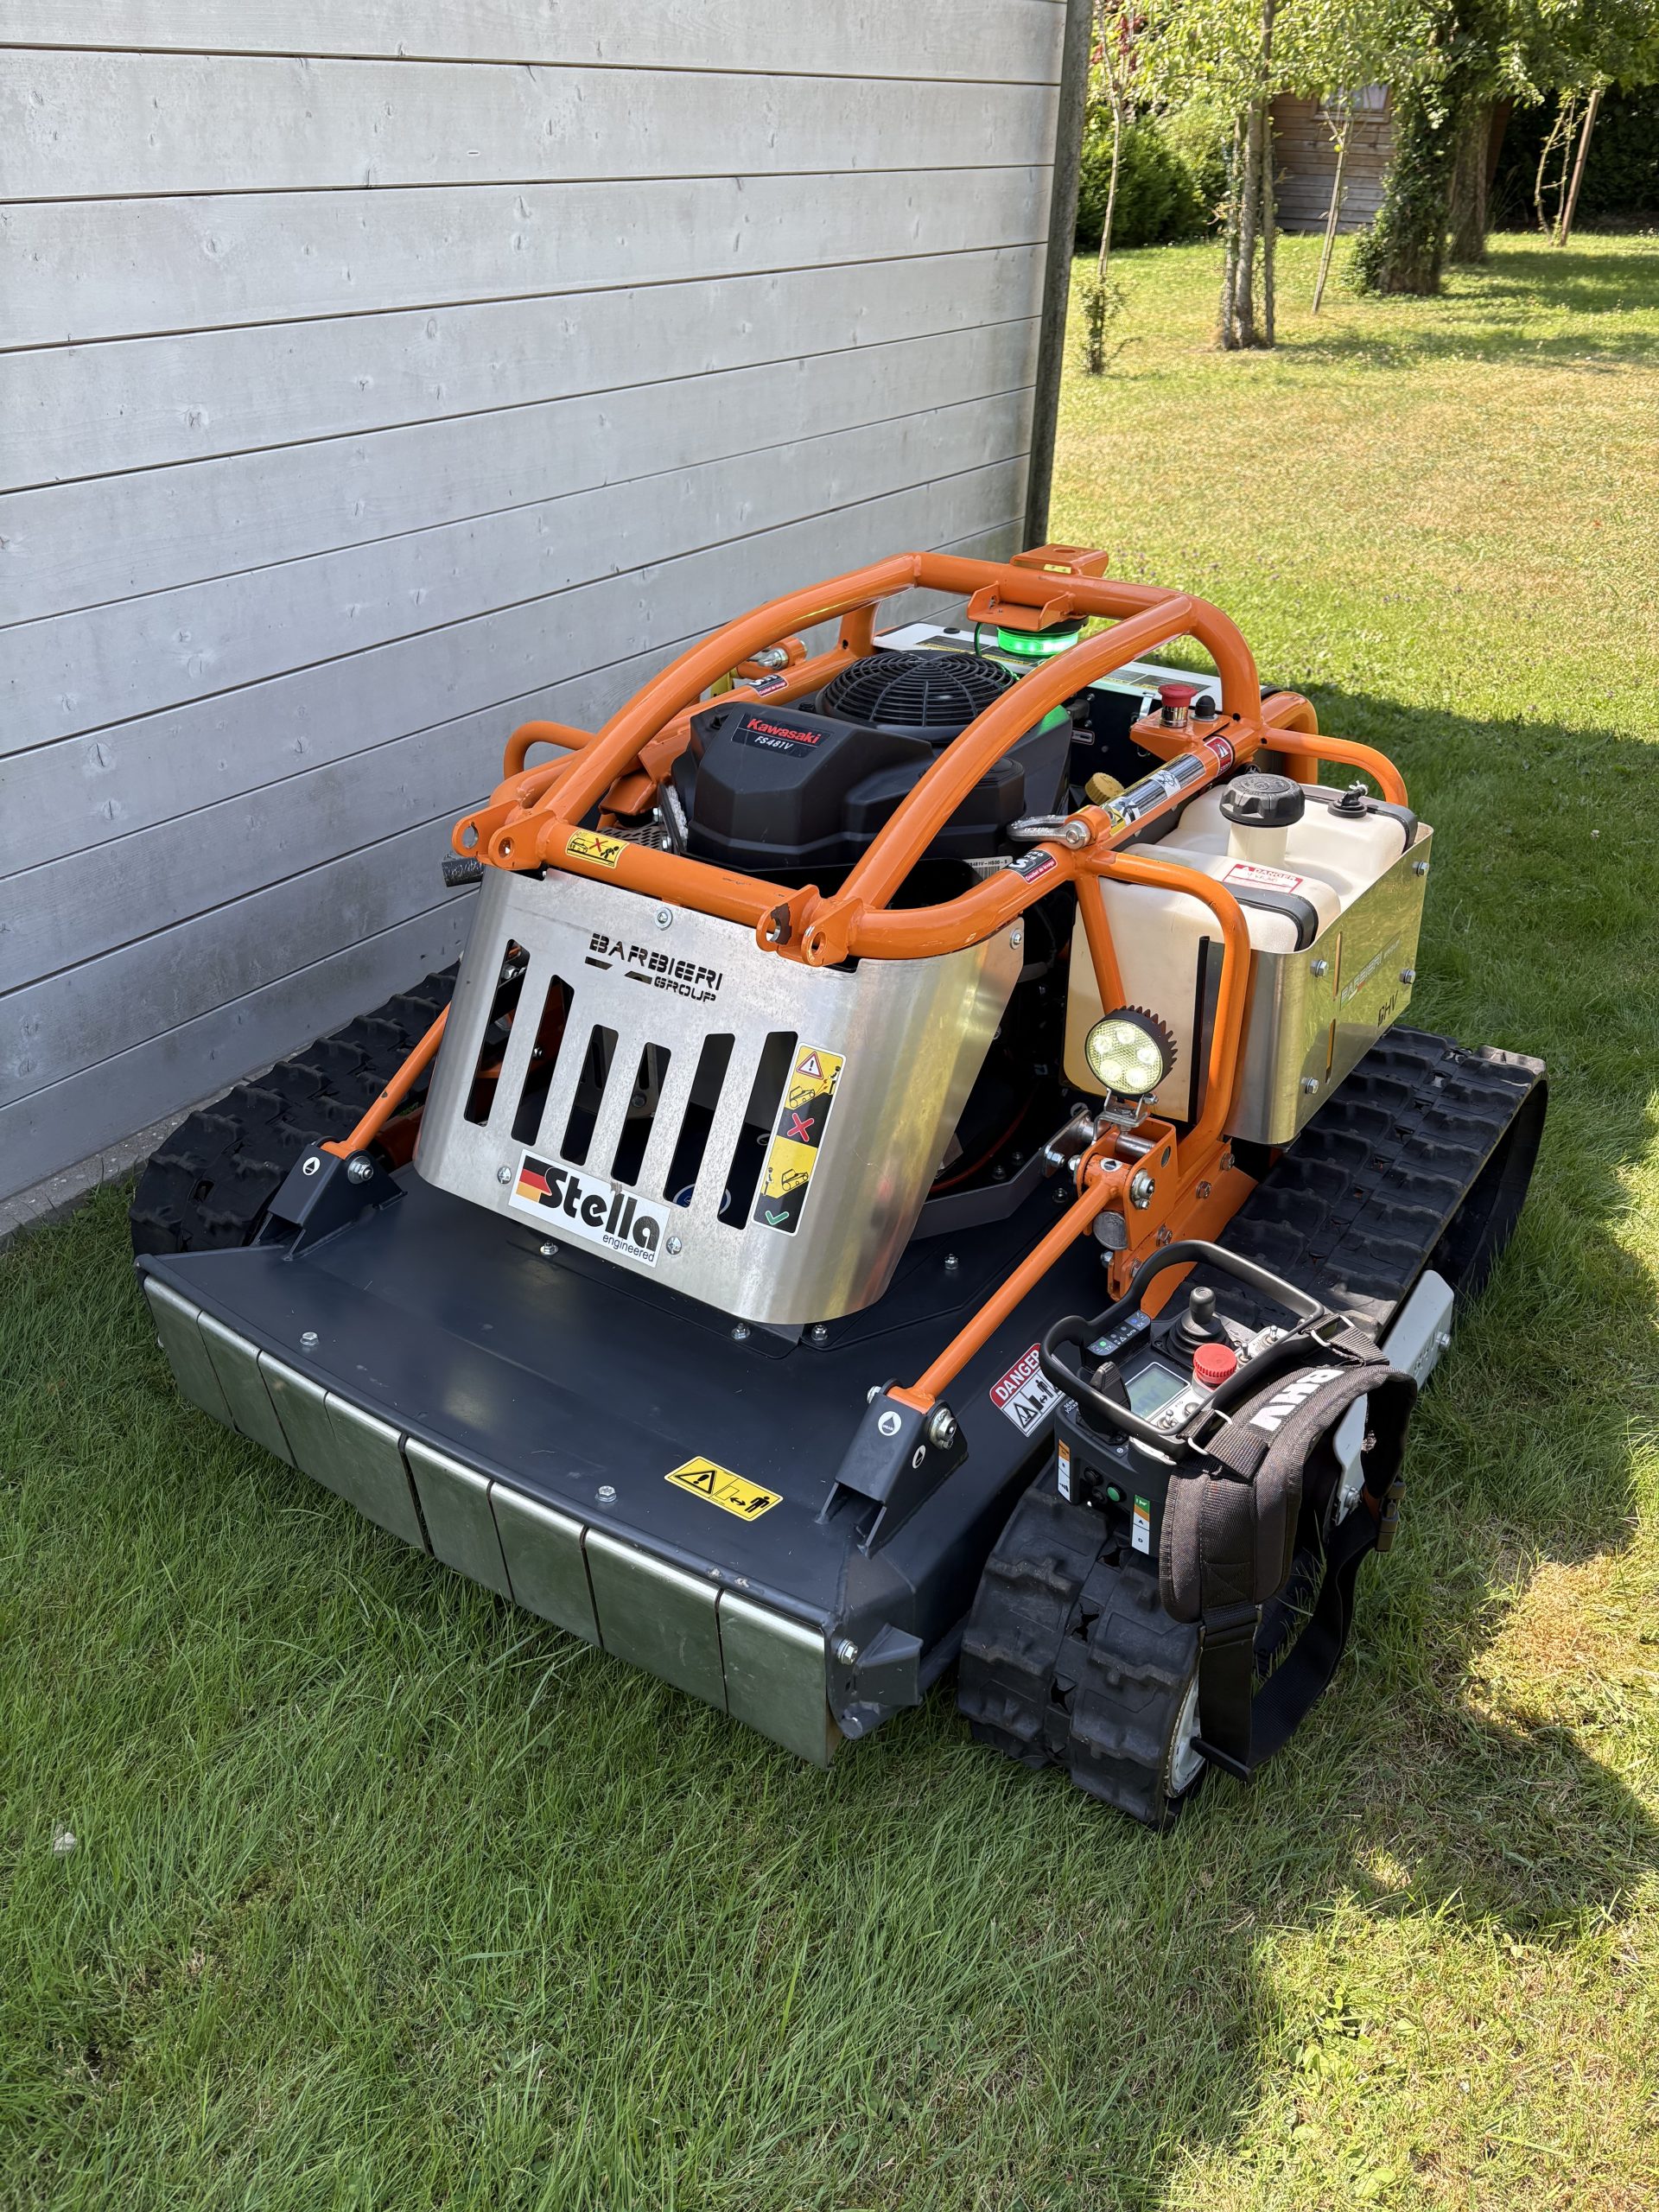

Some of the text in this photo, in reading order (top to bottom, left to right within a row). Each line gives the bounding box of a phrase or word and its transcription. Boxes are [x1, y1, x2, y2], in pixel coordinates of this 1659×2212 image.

[747, 719, 822, 743] Kawasaki
[754, 736, 794, 750] FS481V
[1254, 867, 1294, 881] DANGER
[588, 932, 723, 991] BARBIERI
[653, 976, 716, 1002] GROUP
[537, 1166, 660, 1252] Stella
[602, 1233, 655, 1262] engineered
[995, 1349, 1039, 1401] DANGER
